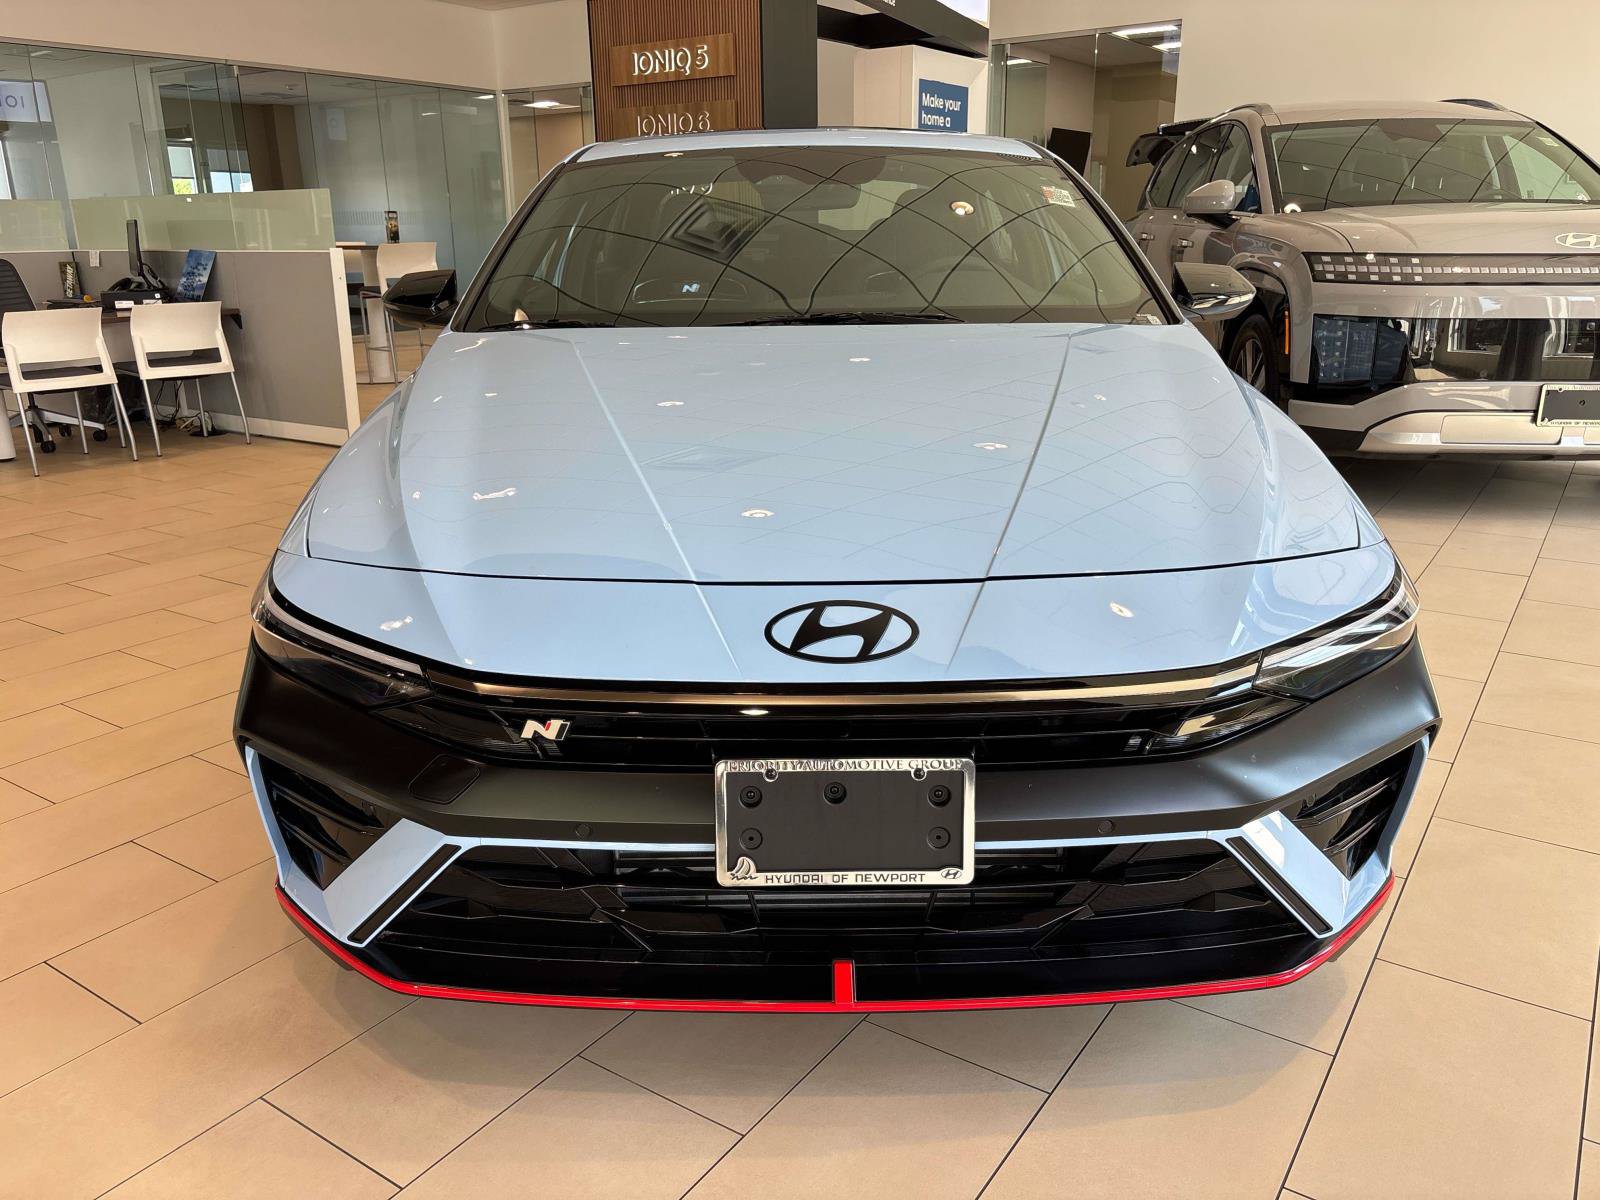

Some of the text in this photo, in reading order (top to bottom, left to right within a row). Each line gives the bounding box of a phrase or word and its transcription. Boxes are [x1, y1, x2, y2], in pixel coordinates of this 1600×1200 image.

[632, 44, 709, 75] IONIQ 5
[922, 92, 961, 112] Make your
[921, 110, 951, 127] home a
[65, 263, 75, 298] GETAWAY
[727, 759, 963, 772] PRIORITY AUTOMOTIVE GROUP
[764, 872, 926, 884] HYUNDAI OF NEWPORT
